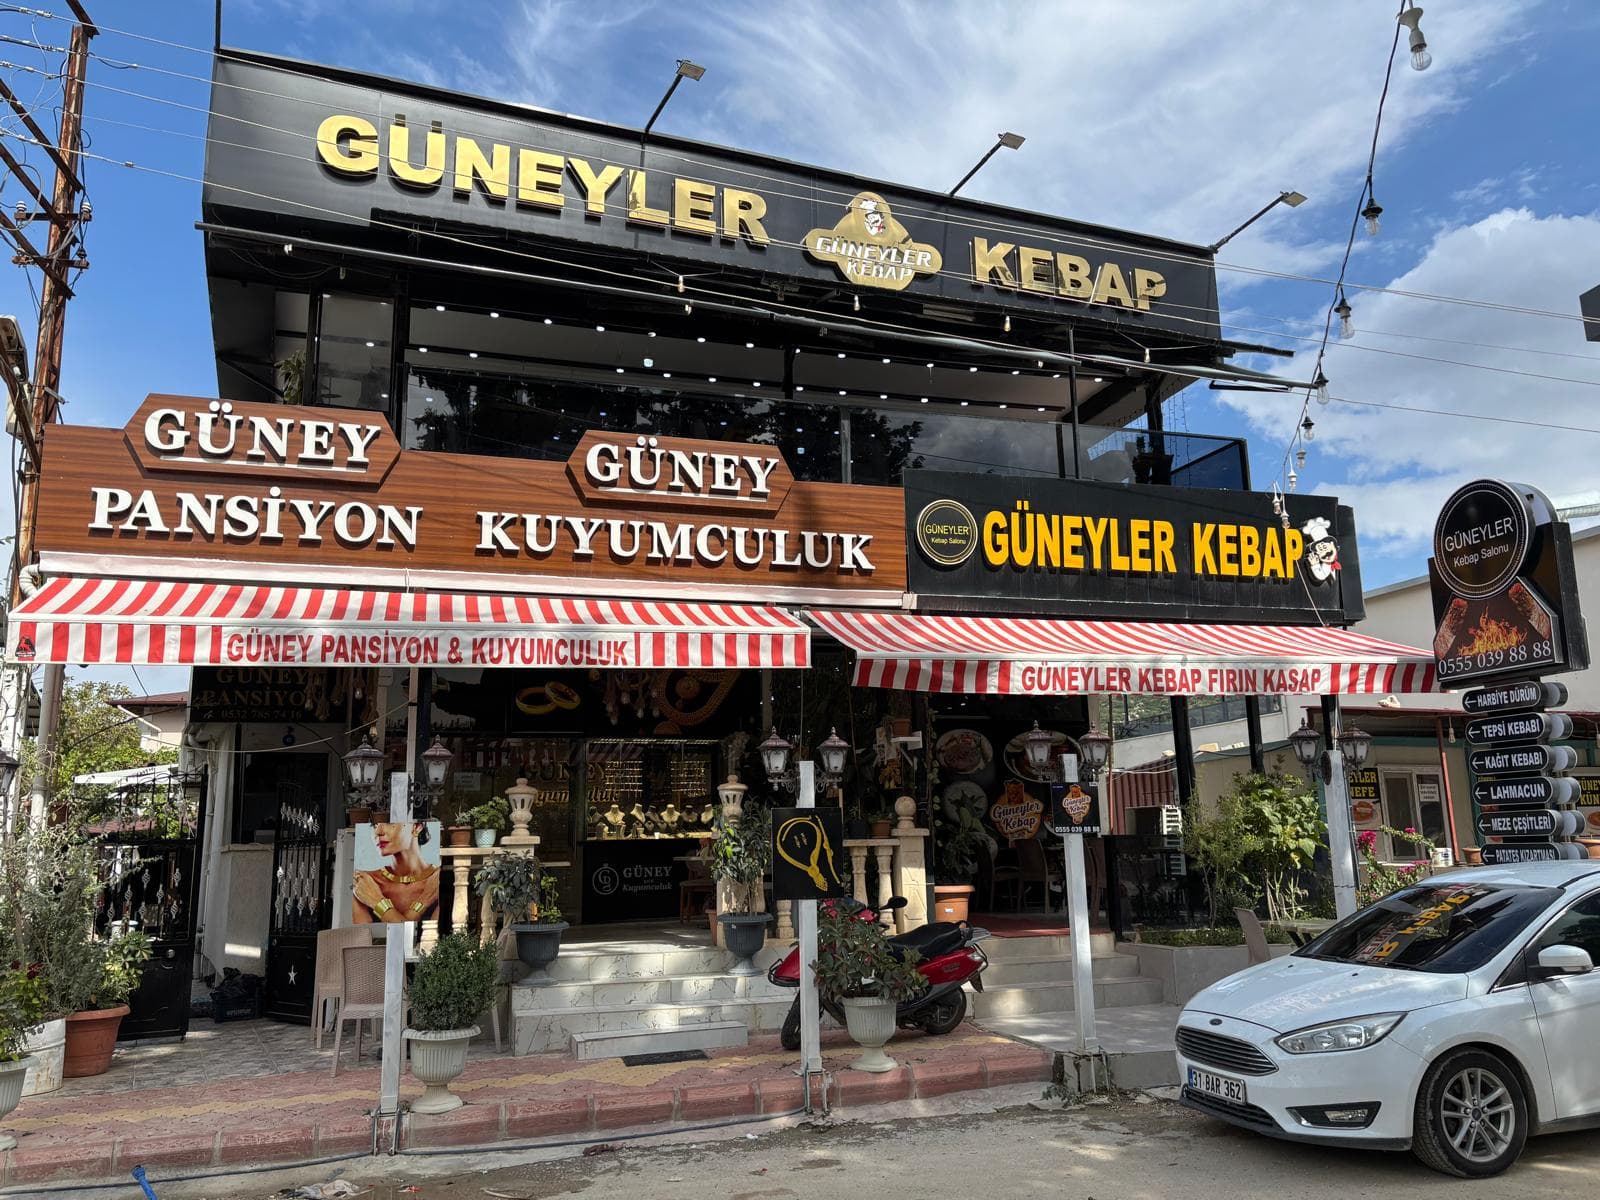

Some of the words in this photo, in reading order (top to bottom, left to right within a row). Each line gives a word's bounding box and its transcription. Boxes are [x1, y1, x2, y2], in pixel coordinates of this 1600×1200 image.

[316, 113, 770, 247] GÜNEYLER
[970, 237, 1167, 311] KEBAP
[815, 235, 932, 267] GÜNEYLER
[846, 258, 914, 281] KEBAP
[144, 401, 382, 464] GÜNEY
[586, 436, 780, 493] GÜNEY
[88, 486, 424, 547] PANSİYON
[925, 523, 969, 535] GÜNEYLER
[475, 511, 876, 571] KUYUMCULUK
[983, 501, 1177, 573] GÜNEYLER
[1193, 522, 1303, 579] KEBAP
[1444, 517, 1514, 552] GÜNEYLER
[1453, 552, 1480, 568] Kebap
[1481, 543, 1509, 559] Salonu
[227, 629, 312, 663] GÜNEY
[321, 630, 439, 665] PANSİYON
[447, 638, 464, 665] &
[471, 636, 628, 666] KUYUMCULUK
[1438, 655, 1473, 675] 0555
[1477, 650, 1504, 668] 039
[1509, 646, 1528, 663] 88
[1533, 641, 1551, 657] 88
[1021, 660, 1131, 692] GÜNEYLER
[1138, 668, 1202, 693] KEBAP
[1208, 667, 1258, 693] FIRIN
[1263, 668, 1321, 693] KASAP
[1477, 690, 1508, 707] HARBİYE
[1509, 686, 1537, 703] DÜRÜM
[1482, 720, 1506, 738] TEPSİ
[1508, 718, 1540, 735] KEBABI
[1485, 751, 1509, 769] KAĞIT
[1511, 751, 1542, 767] KEBABI
[1490, 784, 1545, 800] LAHMACUN
[993, 801, 1040, 818] Güneyler
[1004, 816, 1036, 831] Kebap
[1491, 818, 1512, 831] MEZE
[1512, 814, 1551, 833] ÇEŞİTLERİ
[1495, 849, 1520, 863] PATATES
[622, 865, 672, 878] GÜNEY
[1192, 1071, 1203, 1089] 31
[1205, 1075, 1221, 1094] BAR
[1224, 1080, 1242, 1101] 362
